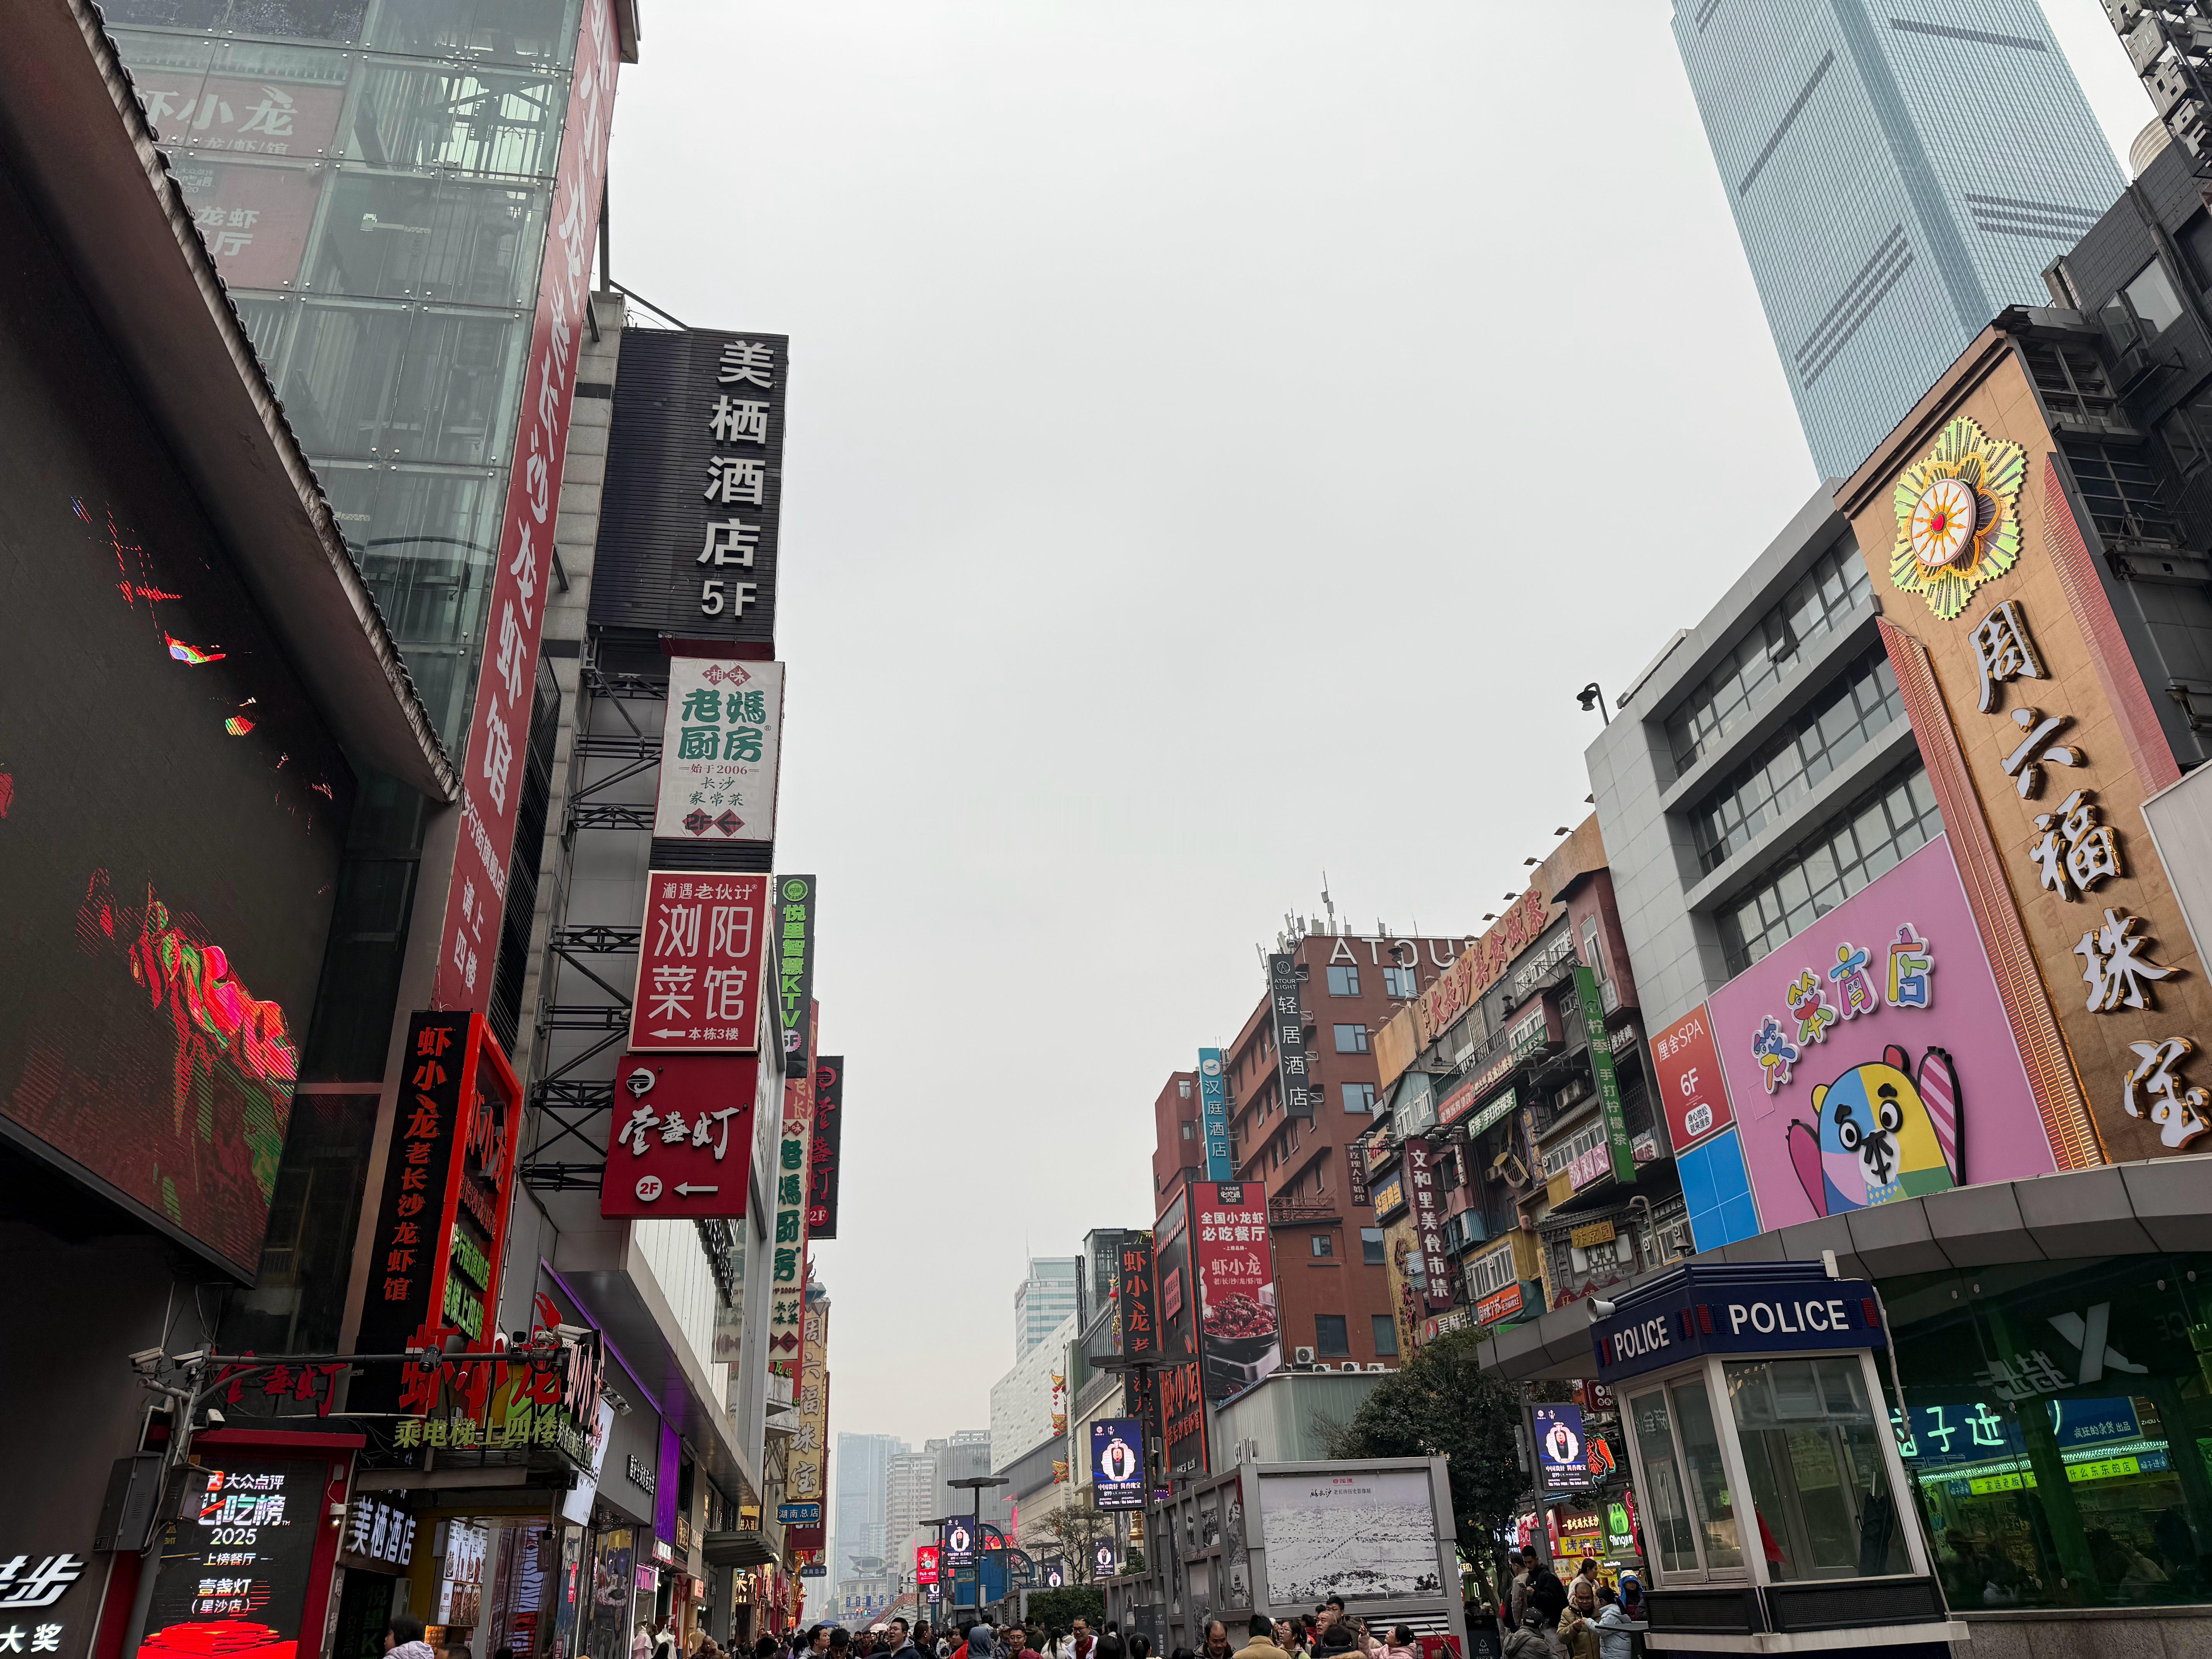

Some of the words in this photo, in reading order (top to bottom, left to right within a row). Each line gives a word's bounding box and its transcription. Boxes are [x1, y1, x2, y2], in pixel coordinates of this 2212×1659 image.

[696, 340, 776, 570] 美栖酒店
[701, 580, 757, 618] 5F
[706, 668, 746, 684] 湘味
[677, 725, 764, 762] 厨房
[691, 764, 748, 775] 始于2006
[701, 776, 735, 791] 长沙
[689, 792, 744, 806] 家常菜
[685, 814, 713, 831] 2F
[463, 788, 504, 902] 步行街旗舰店
[1969, 599, 2211, 1149] 周六福珠宝
[653, 903, 754, 958] 浏阳
[781, 904, 806, 1028] 悦里智慧KTV
[648, 965, 747, 1020] 菜馆
[688, 1027, 739, 1041] 本栋3楼
[1657, 1018, 1704, 1063] 厘舍SPA
[1278, 996, 1308, 1106] 轻居酒店
[1587, 1019, 1608, 1054] 柠季
[1600, 1069, 1627, 1146] 手打柠檬茶
[1681, 1067, 1699, 1096] 6F
[1205, 1080, 1226, 1157] 汉庭酒店
[383, 1027, 452, 1301] 虾小龙老长沙龙虾馆
[640, 1182, 659, 1194] 2F
[810, 1210, 826, 1221] 2F
[1201, 1212, 1264, 1224] 全国小龙虾
[1410, 1150, 1449, 1297] 文和里美食市集
[1202, 1226, 1266, 1242] 必吃餐厅
[1212, 1252, 1262, 1276] 虾小龙
[1729, 1300, 1850, 1335] POLICE
[1613, 1316, 1670, 1362] POLICE
[789, 1317, 822, 1494] 周六福珠宝
[393, 1415, 559, 1448] 乘电梯上四楼
[2074, 1421, 2115, 1438] 疯狂的杂货
[2116, 1421, 2131, 1432] 出品
[224, 1473, 285, 1490] 大众点评
[779, 1508, 820, 1519] 湖南总店
[210, 1528, 257, 1545] 2025
[351, 1495, 416, 1566] 美栖酒店
[203, 1553, 256, 1566] 上榜餐厅
[197, 1578, 252, 1597] 壹盏灯
